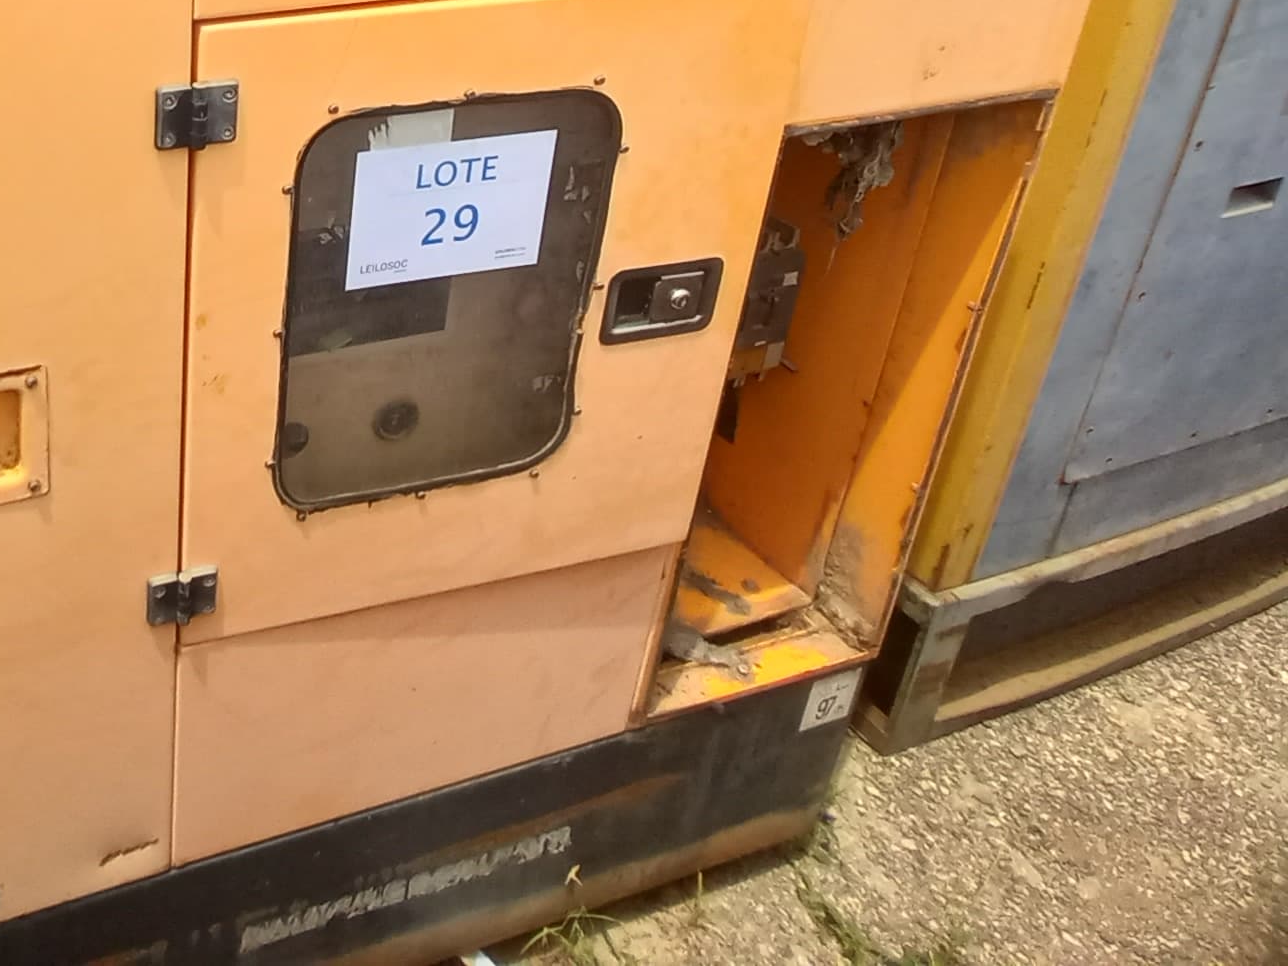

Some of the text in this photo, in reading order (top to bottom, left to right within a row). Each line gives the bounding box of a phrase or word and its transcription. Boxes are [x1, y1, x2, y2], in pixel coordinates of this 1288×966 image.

[415, 155, 499, 189] LOTE
[420, 204, 479, 246] 29
[359, 258, 409, 275] LEILOSOC
[816, 695, 838, 720] 97
